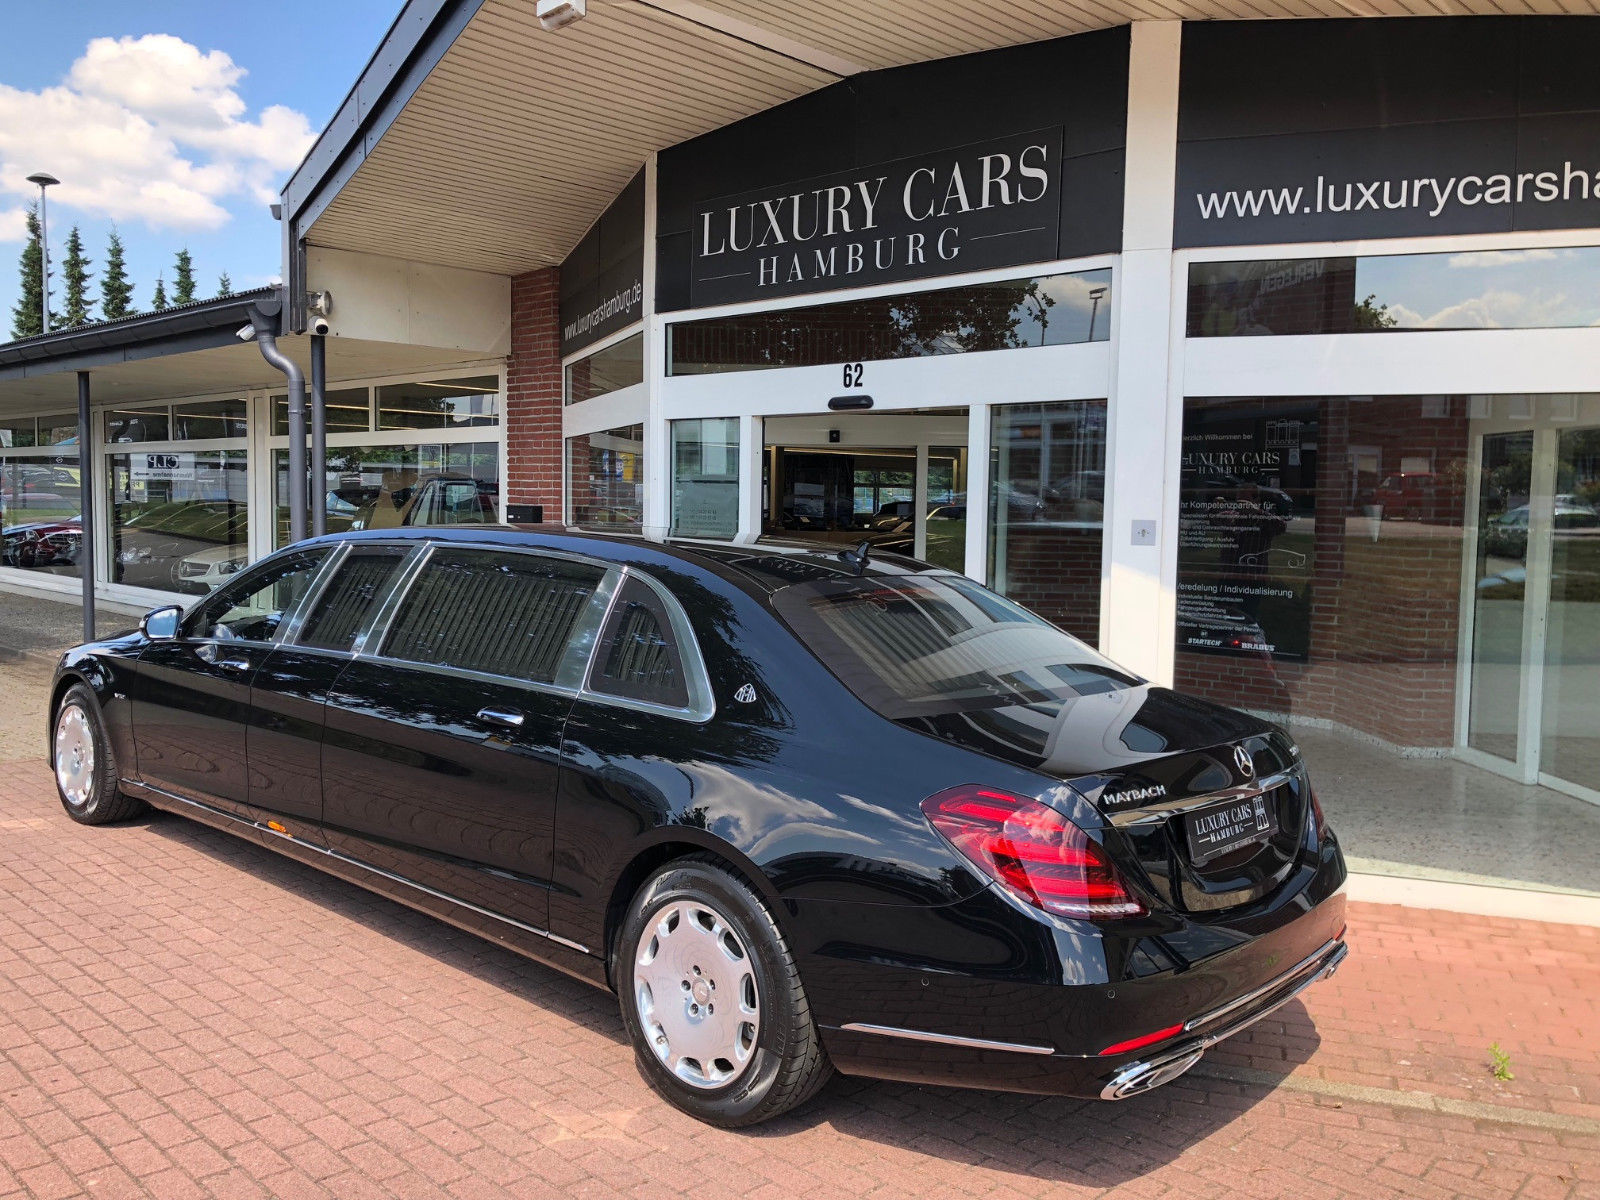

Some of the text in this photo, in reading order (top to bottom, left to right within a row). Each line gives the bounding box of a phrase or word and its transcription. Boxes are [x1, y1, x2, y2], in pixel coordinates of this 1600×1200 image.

[1197, 161, 1600, 218] www.luxurycarsh
[700, 144, 1048, 258] LUXURY CARS
[757, 227, 962, 287] HAMBURG
[842, 363, 864, 388] 62
[1242, 451, 1280, 464] CARS
[1198, 466, 1259, 474] HAMBURG
[1225, 585, 1293, 598] Individualisierung
[1188, 638, 1221, 647] STARTECH
[1241, 642, 1275, 652] BRABUS
[1103, 785, 1166, 805] MAYBACH
[1195, 803, 1252, 836] LUXURY CARS
[1210, 823, 1244, 843] HAMBURG
